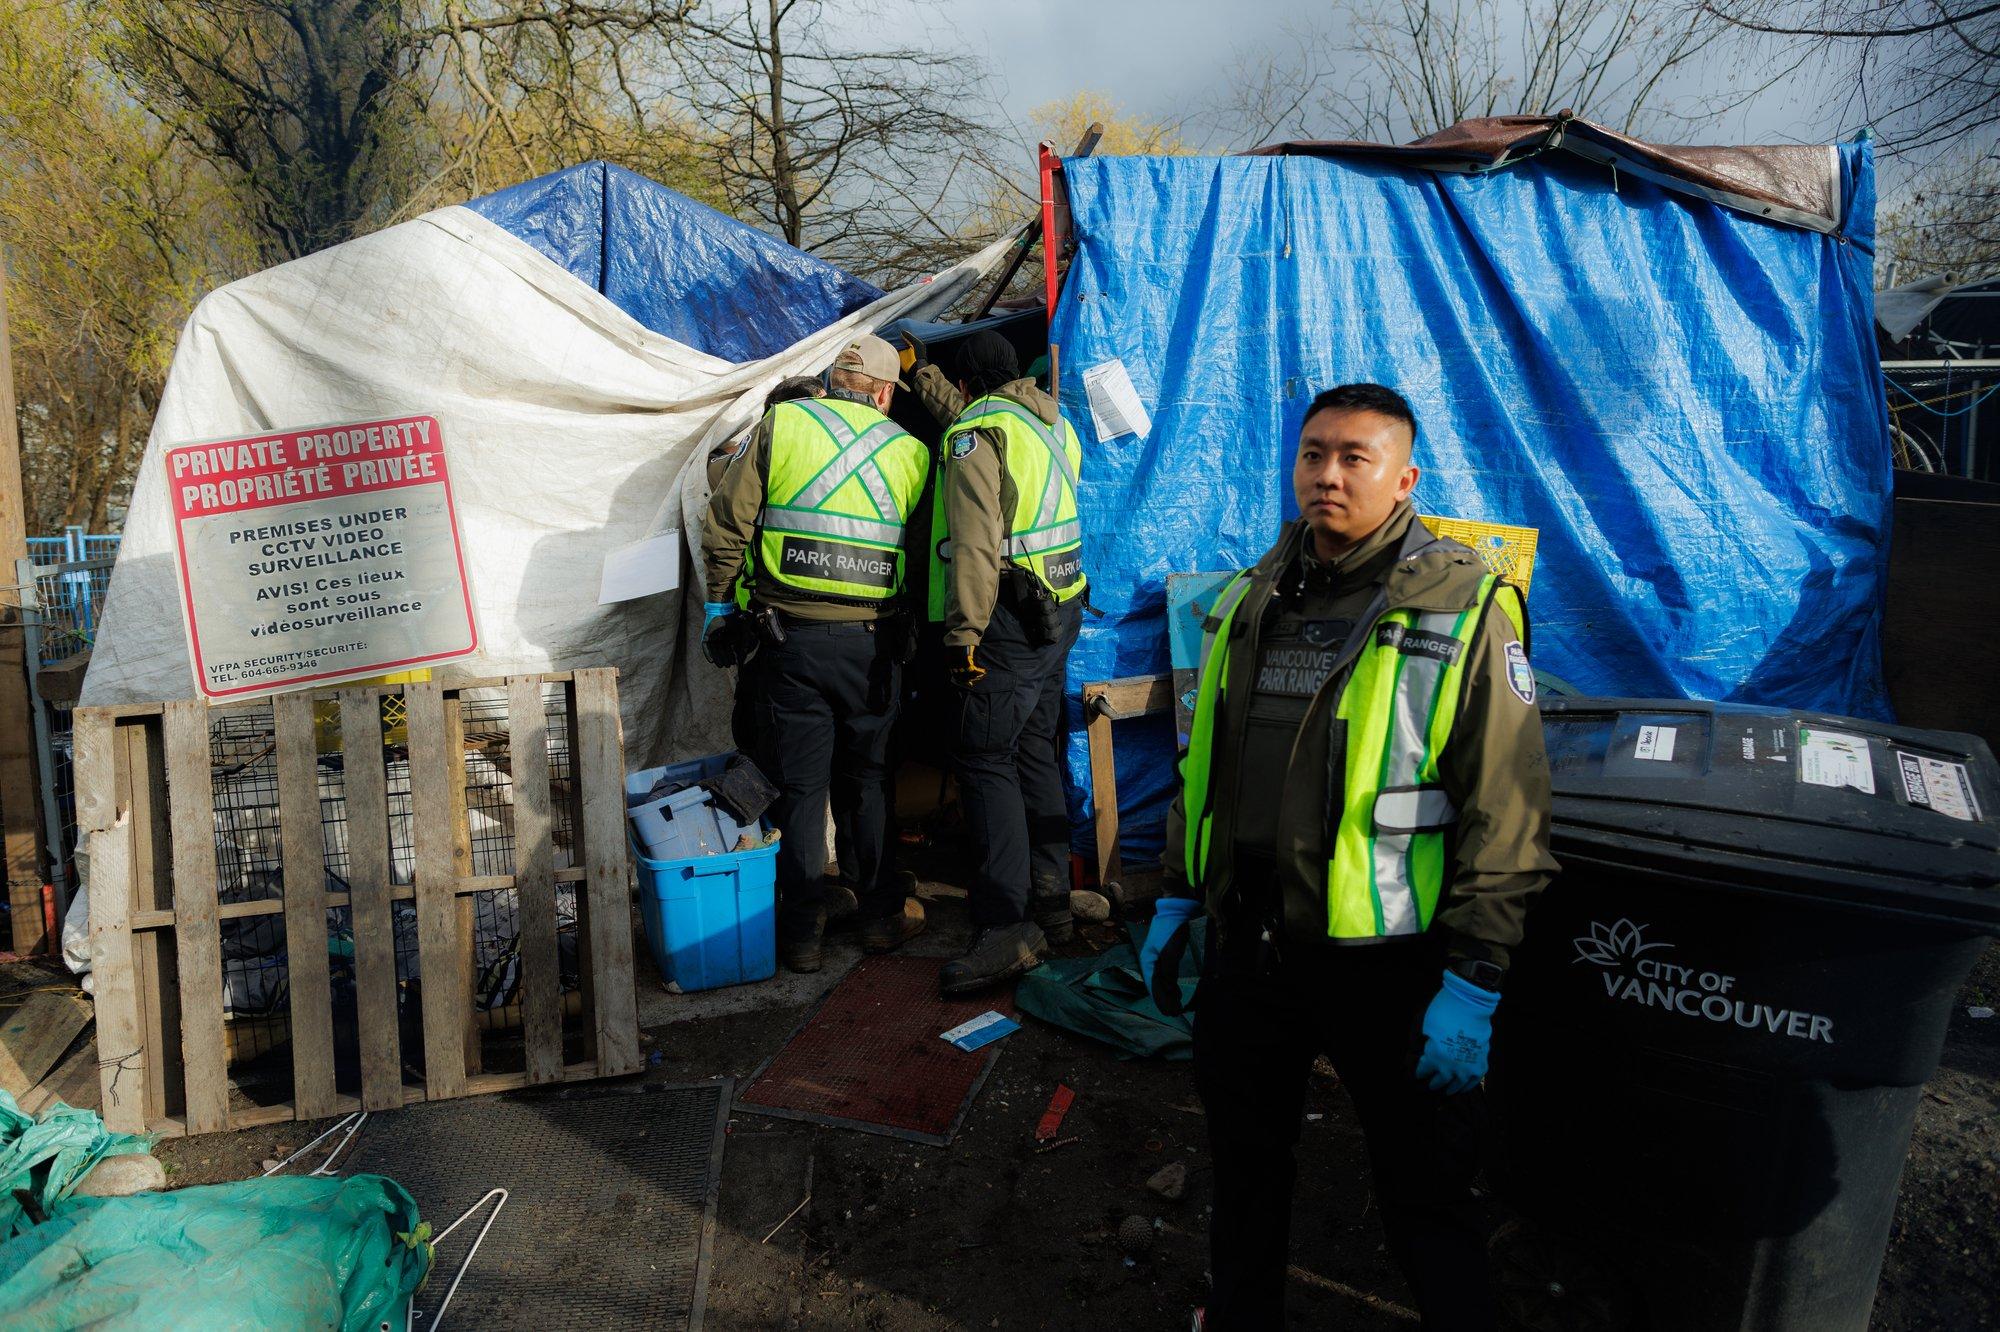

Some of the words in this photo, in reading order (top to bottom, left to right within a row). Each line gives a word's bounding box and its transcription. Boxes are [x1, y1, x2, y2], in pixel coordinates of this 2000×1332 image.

[172, 440, 287, 479] PRIVATE
[296, 420, 431, 461] PROPERTY
[182, 462, 333, 511] PROPRIÉTÉ
[343, 450, 436, 488] PRIVÉE
[229, 518, 332, 544] PREMISES
[339, 507, 408, 528] UNDER
[261, 537, 316, 557] CCTV
[322, 527, 384, 547] VIDEO
[248, 541, 402, 577] SURVEILLANCE
[786, 548, 832, 567] PARK
[836, 555, 892, 577] RANGER
[1049, 561, 1075, 579] PARK
[256, 582, 309, 602] AVIS!
[315, 575, 351, 592] Ces
[358, 568, 405, 587] lieux
[286, 597, 330, 614] sont
[336, 590, 381, 607] sous
[1381, 628, 1402, 641] PAR
[1403, 637, 1457, 659] RANGER
[210, 662, 241, 674] VFPA
[211, 673, 238, 684] TEL.
[241, 659, 318, 679] 604-665-9346
[1257, 666, 1288, 691] PARK
[1287, 669, 1328, 694] RANG
[1903, 759, 1919, 773] BIN
[1637, 959, 1694, 985] CITY
[1699, 972, 1736, 993] OF
[1603, 971, 1834, 1043] VANCOUVER
